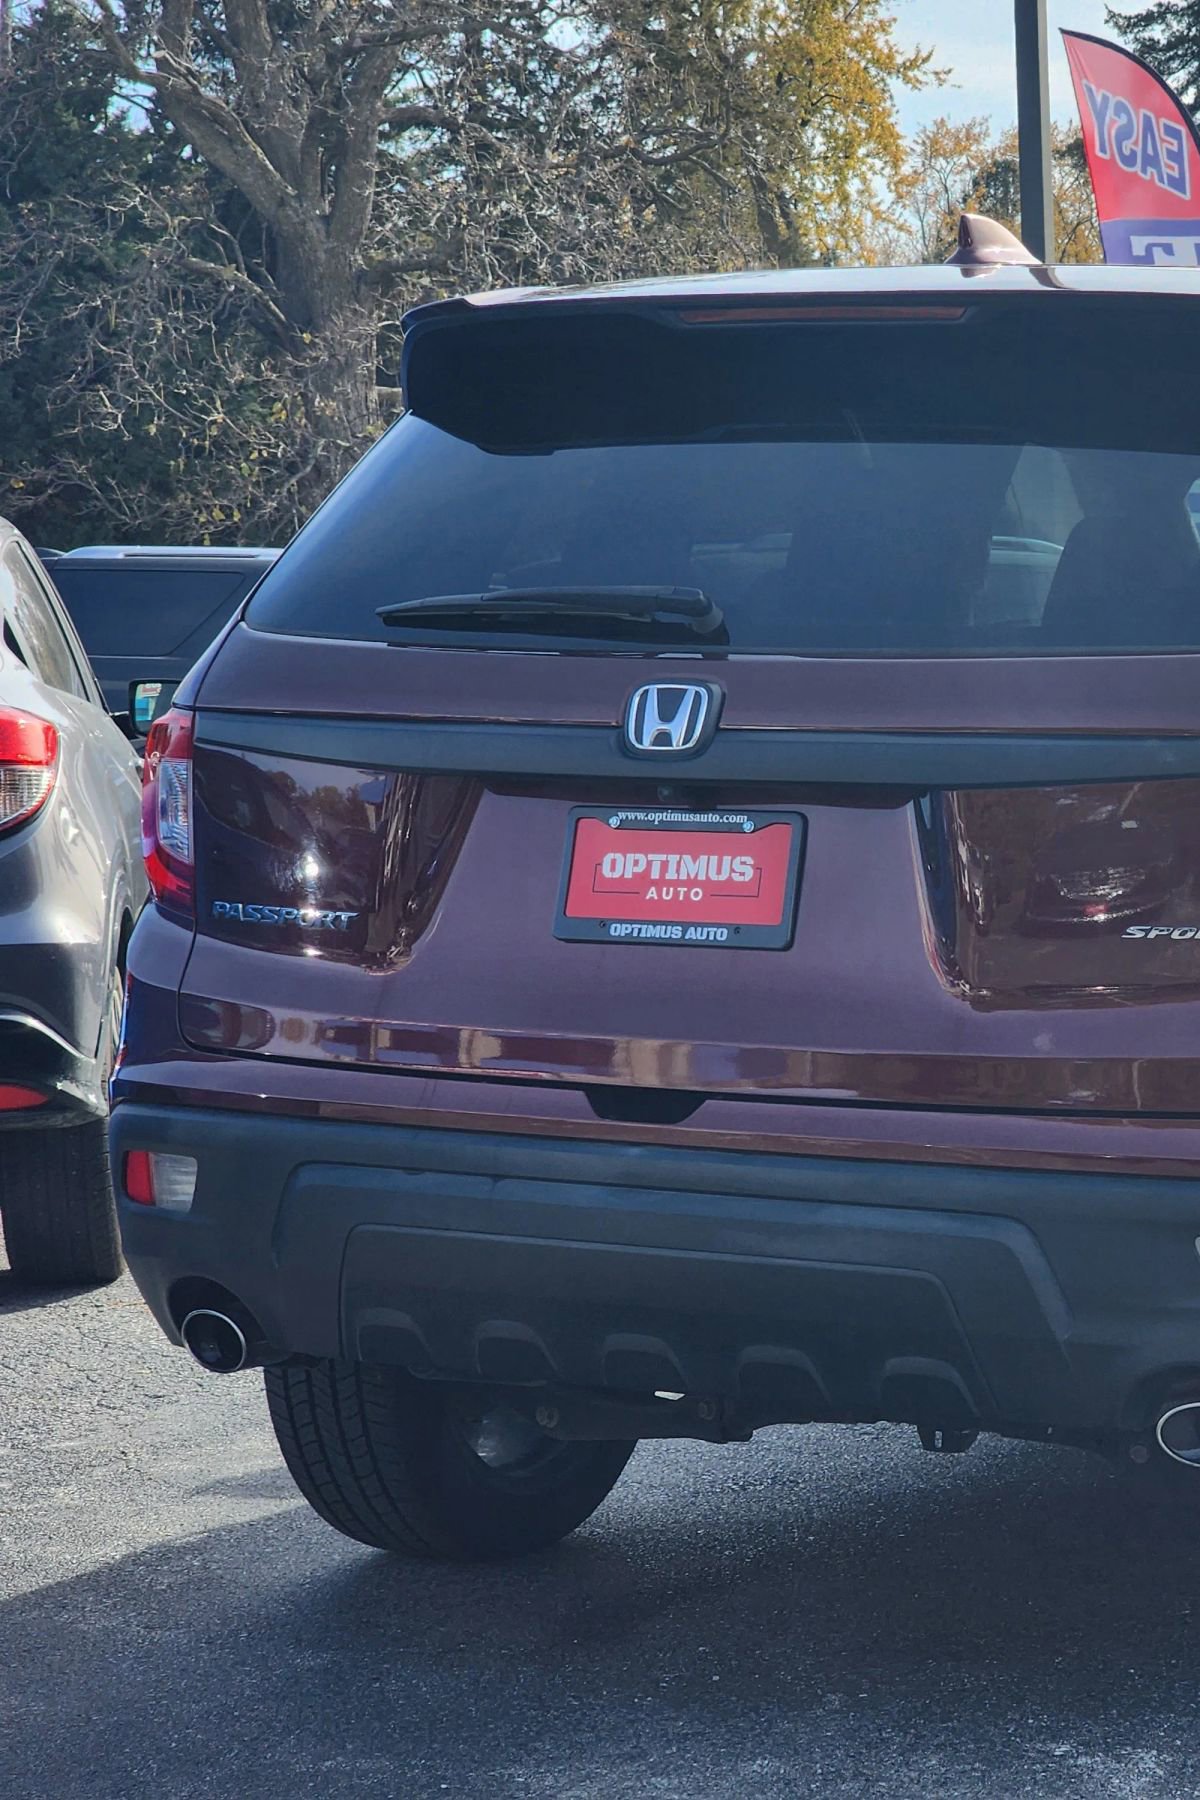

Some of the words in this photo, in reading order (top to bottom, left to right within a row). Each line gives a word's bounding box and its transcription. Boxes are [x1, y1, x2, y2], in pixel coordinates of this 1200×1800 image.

[617, 810, 748, 825] www.optimusauto.com
[601, 853, 754, 882] OPTIMUS
[645, 887, 704, 901] AUTO
[211, 901, 360, 929] PASSPORT
[609, 923, 682, 940] OPTIMUS
[685, 926, 729, 941] AUTO
